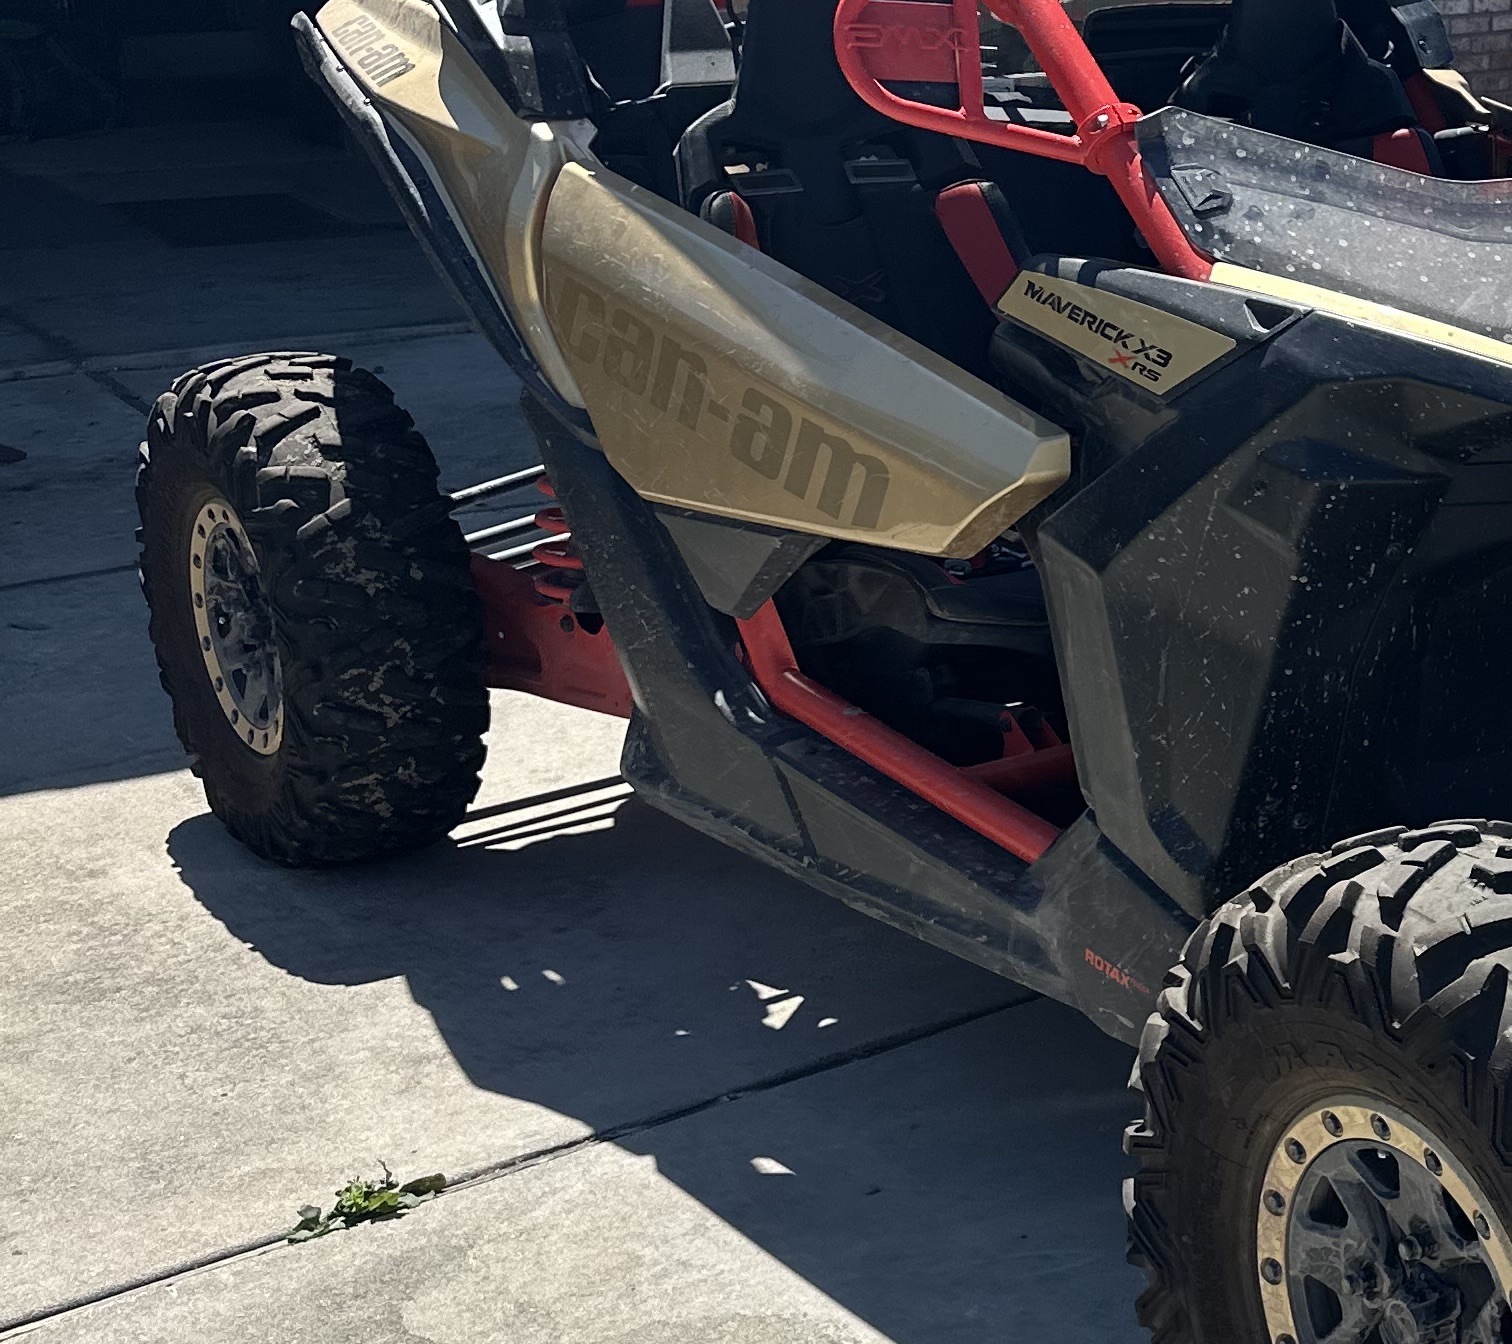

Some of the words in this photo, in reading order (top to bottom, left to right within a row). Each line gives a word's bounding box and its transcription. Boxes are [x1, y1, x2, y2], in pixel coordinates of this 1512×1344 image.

[1023, 279, 1136, 351] MAVERICK
[1131, 337, 1173, 369] X3
[560, 276, 890, 529] can-am
[1084, 947, 1130, 990] ROTAX
